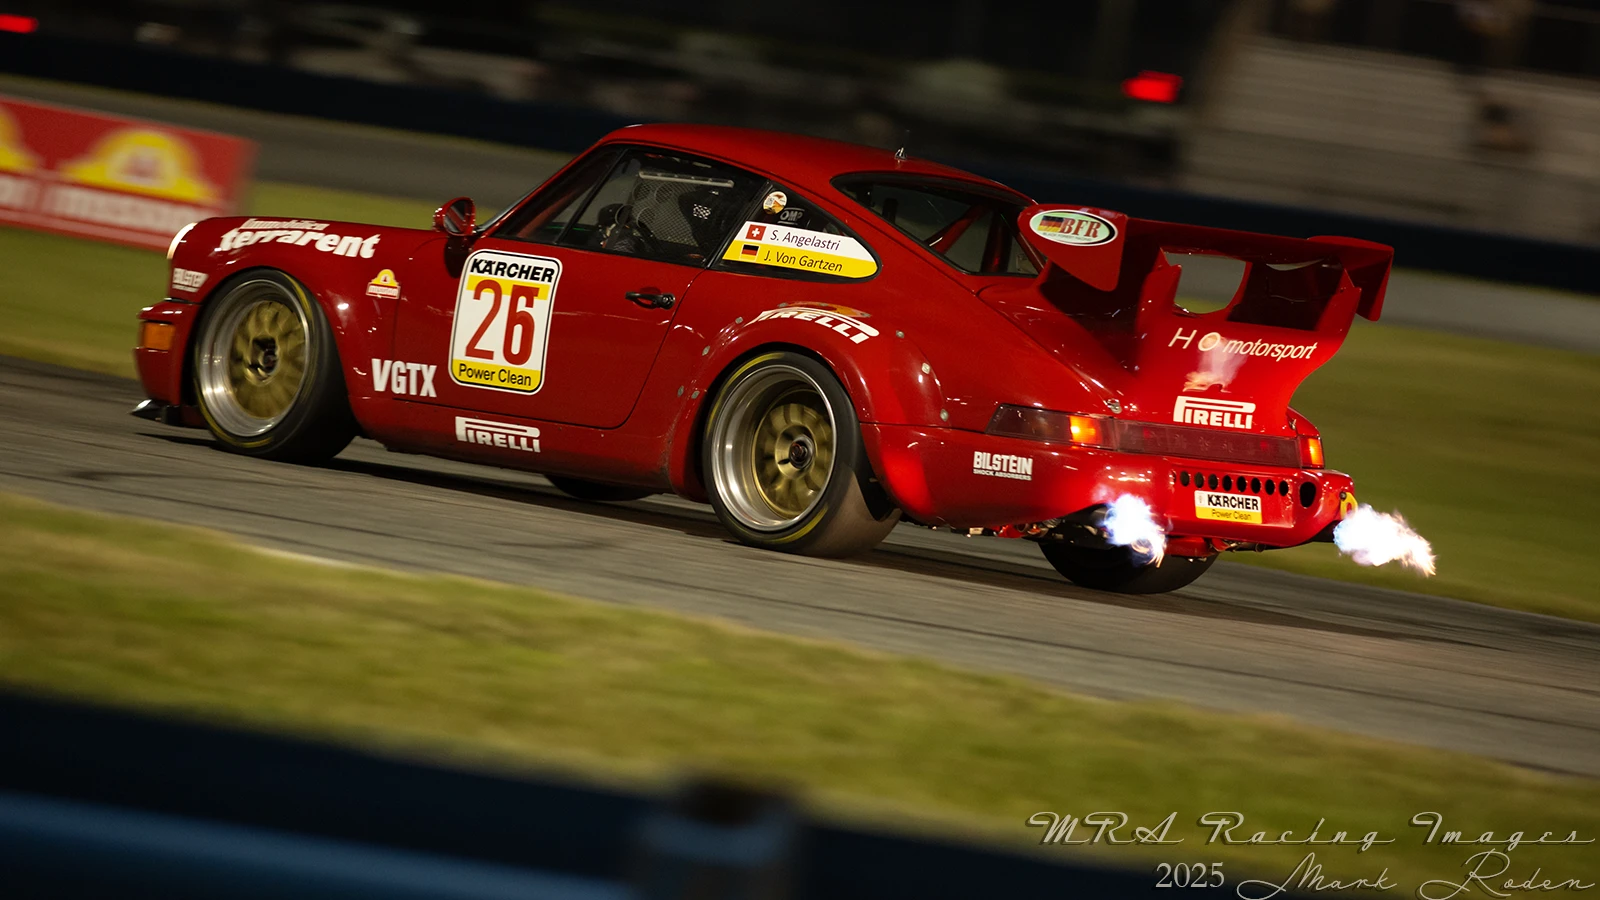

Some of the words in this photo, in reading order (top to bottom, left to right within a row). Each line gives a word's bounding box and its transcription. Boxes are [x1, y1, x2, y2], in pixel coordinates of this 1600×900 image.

[1059, 217, 1101, 238] BFR
[219, 228, 381, 259] terrarent
[770, 229, 779, 242] S.
[782, 231, 841, 251] Angelastri
[470, 258, 555, 283] KÄRCHER
[763, 250, 771, 262] J.
[776, 251, 796, 265] Von
[799, 255, 843, 272] Gartzen
[465, 279, 540, 366] 26
[1168, 327, 1197, 349] H
[1222, 338, 1318, 362] motorsport
[371, 358, 437, 397] VGTX
[458, 363, 496, 383] Power
[498, 368, 532, 387] Clean
[1173, 395, 1256, 430] PIRELLI
[455, 415, 541, 453] PIRELLI
[973, 451, 1033, 475] BILSTEIN
[1207, 493, 1259, 511] KÄRCHER
[1212, 508, 1232, 519] Power
[1233, 510, 1252, 521] Clean
